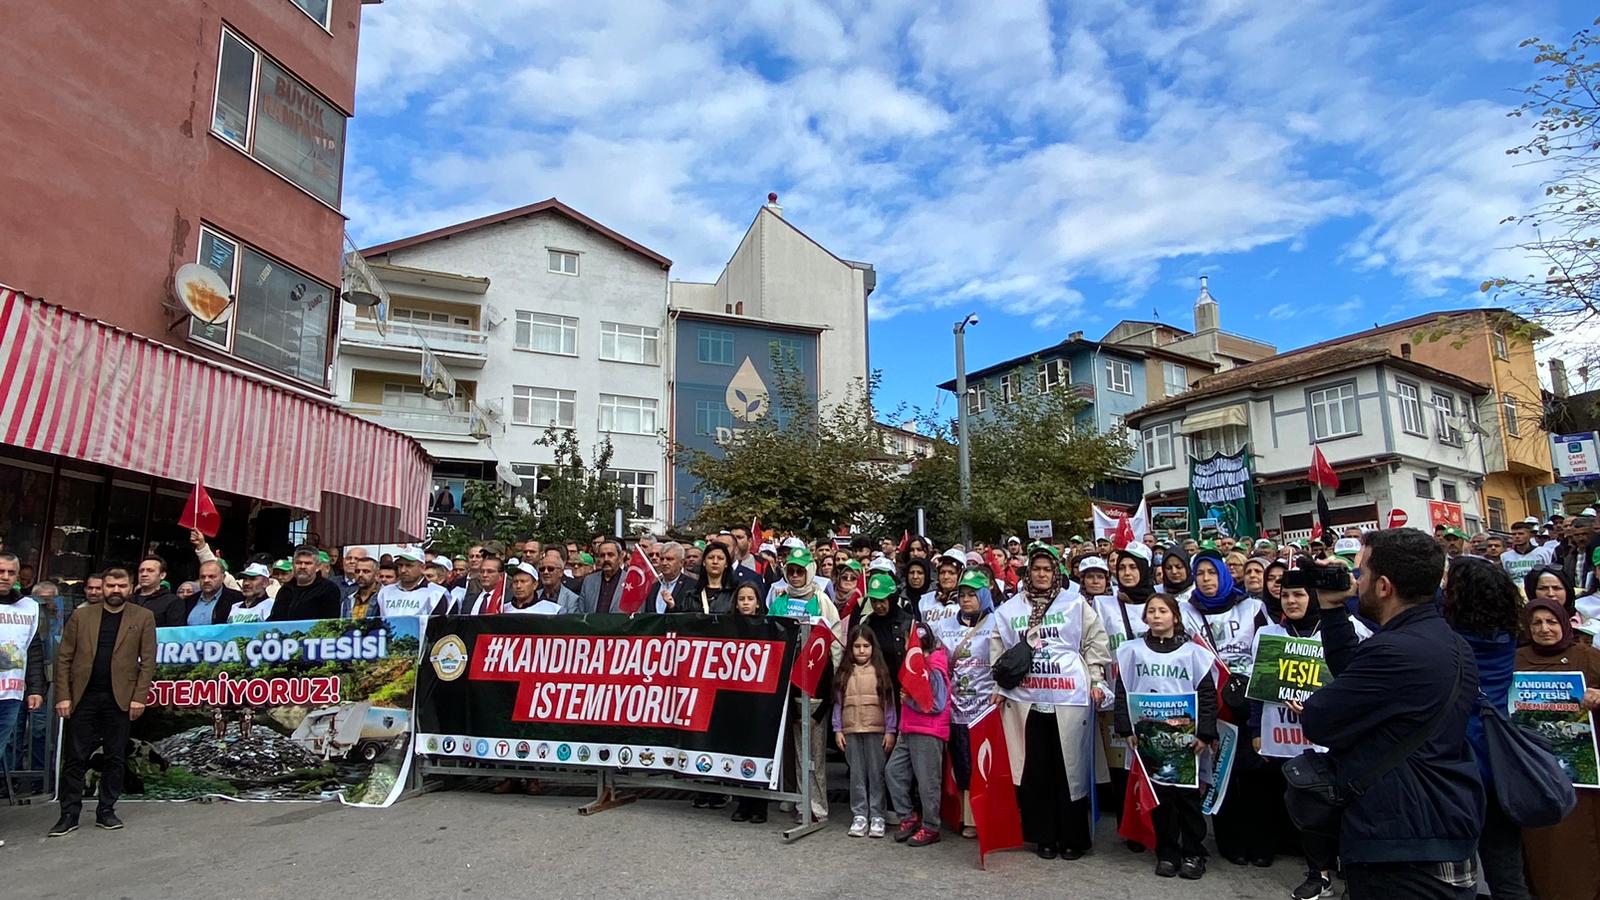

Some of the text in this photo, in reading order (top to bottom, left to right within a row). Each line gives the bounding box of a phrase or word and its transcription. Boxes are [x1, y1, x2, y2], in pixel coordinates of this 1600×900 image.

[385, 599, 420, 609] TARIMA
[245, 632, 298, 668] ÇÖP
[303, 628, 388, 661] TESİSİ
[1284, 641, 1325, 659] KANDIRA
[482, 632, 772, 683] #KANDIRA'DAÇÖPTESİSİ
[1135, 663, 1190, 681] TARIMA
[1278, 658, 1323, 688] YEŞİL
[1514, 681, 1574, 690] KANDIRA'DA
[1518, 689, 1571, 701] ÇÖP TESİSİ
[528, 682, 699, 727] İSTEMİYORUZ!
[1138, 700, 1189, 709] KANDIRA'DA
